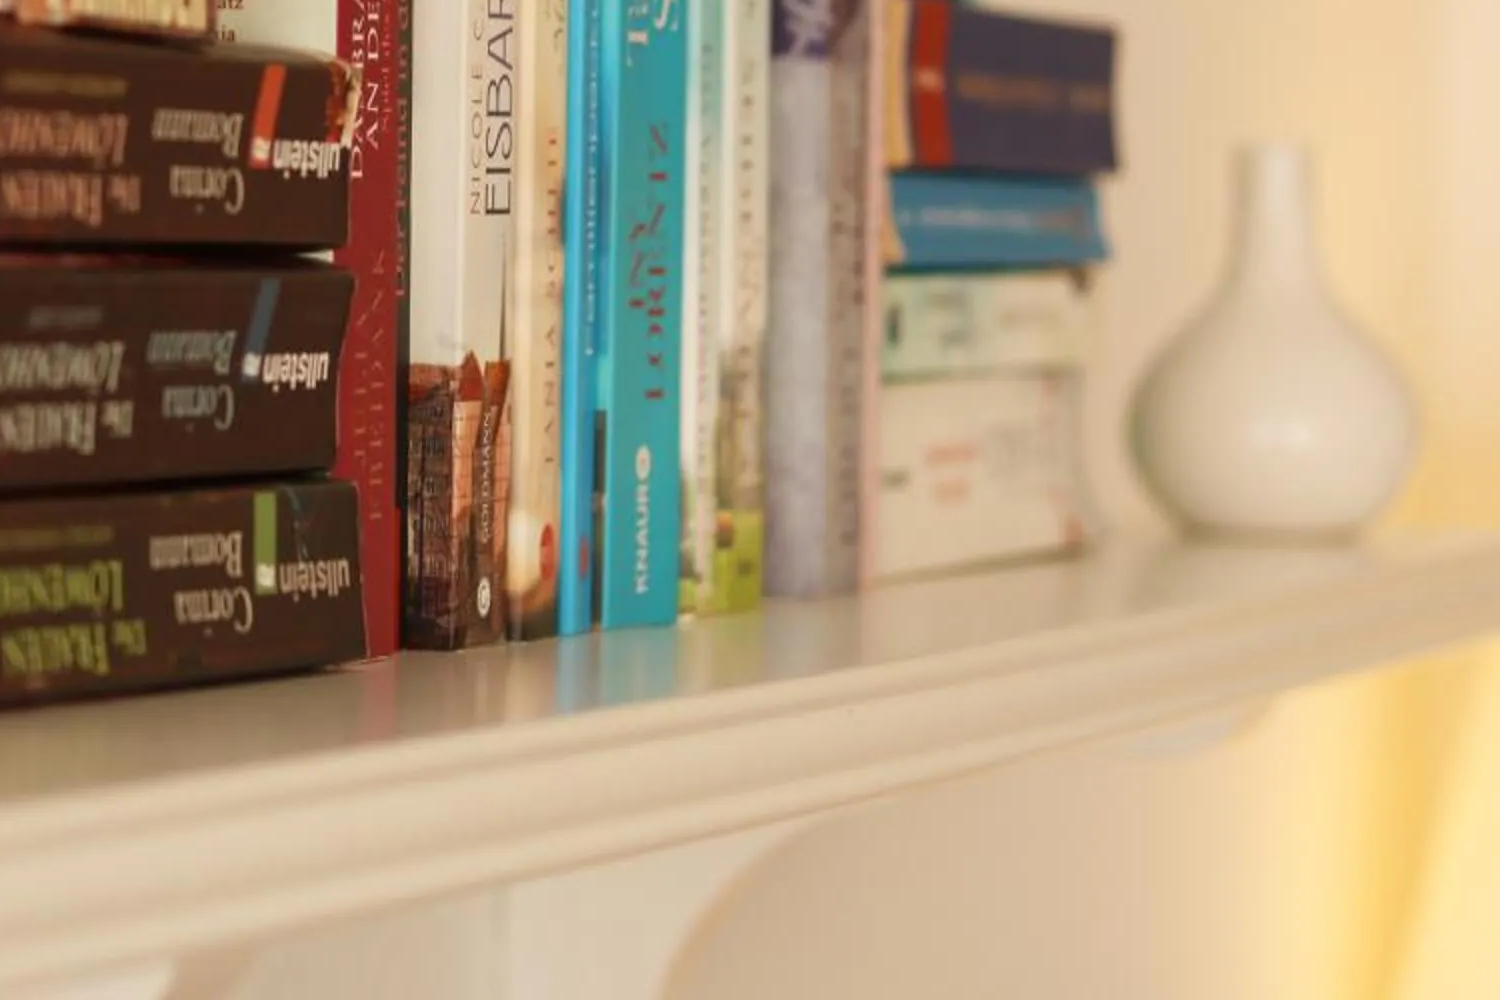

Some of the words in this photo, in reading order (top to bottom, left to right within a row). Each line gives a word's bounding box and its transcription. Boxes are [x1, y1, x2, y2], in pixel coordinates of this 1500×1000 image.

[151, 107, 245, 158] Bomann
[367, 81, 379, 150] AN
[470, 64, 483, 216] NICOLE
[272, 136, 341, 179] ullstein
[169, 164, 245, 216] Corina
[643, 121, 670, 401] LORENTZ
[146, 329, 238, 378] Bomann
[261, 349, 330, 393] ullstein
[161, 384, 237, 432] Corina
[353, 311, 369, 466] JULIA
[368, 246, 386, 521] FREIDANK
[480, 411, 492, 545] GOLDMANN
[148, 529, 244, 578] Bomann
[634, 483, 649, 595] KNAUR
[279, 556, 351, 601] ullstein
[174, 585, 254, 638] Corina
